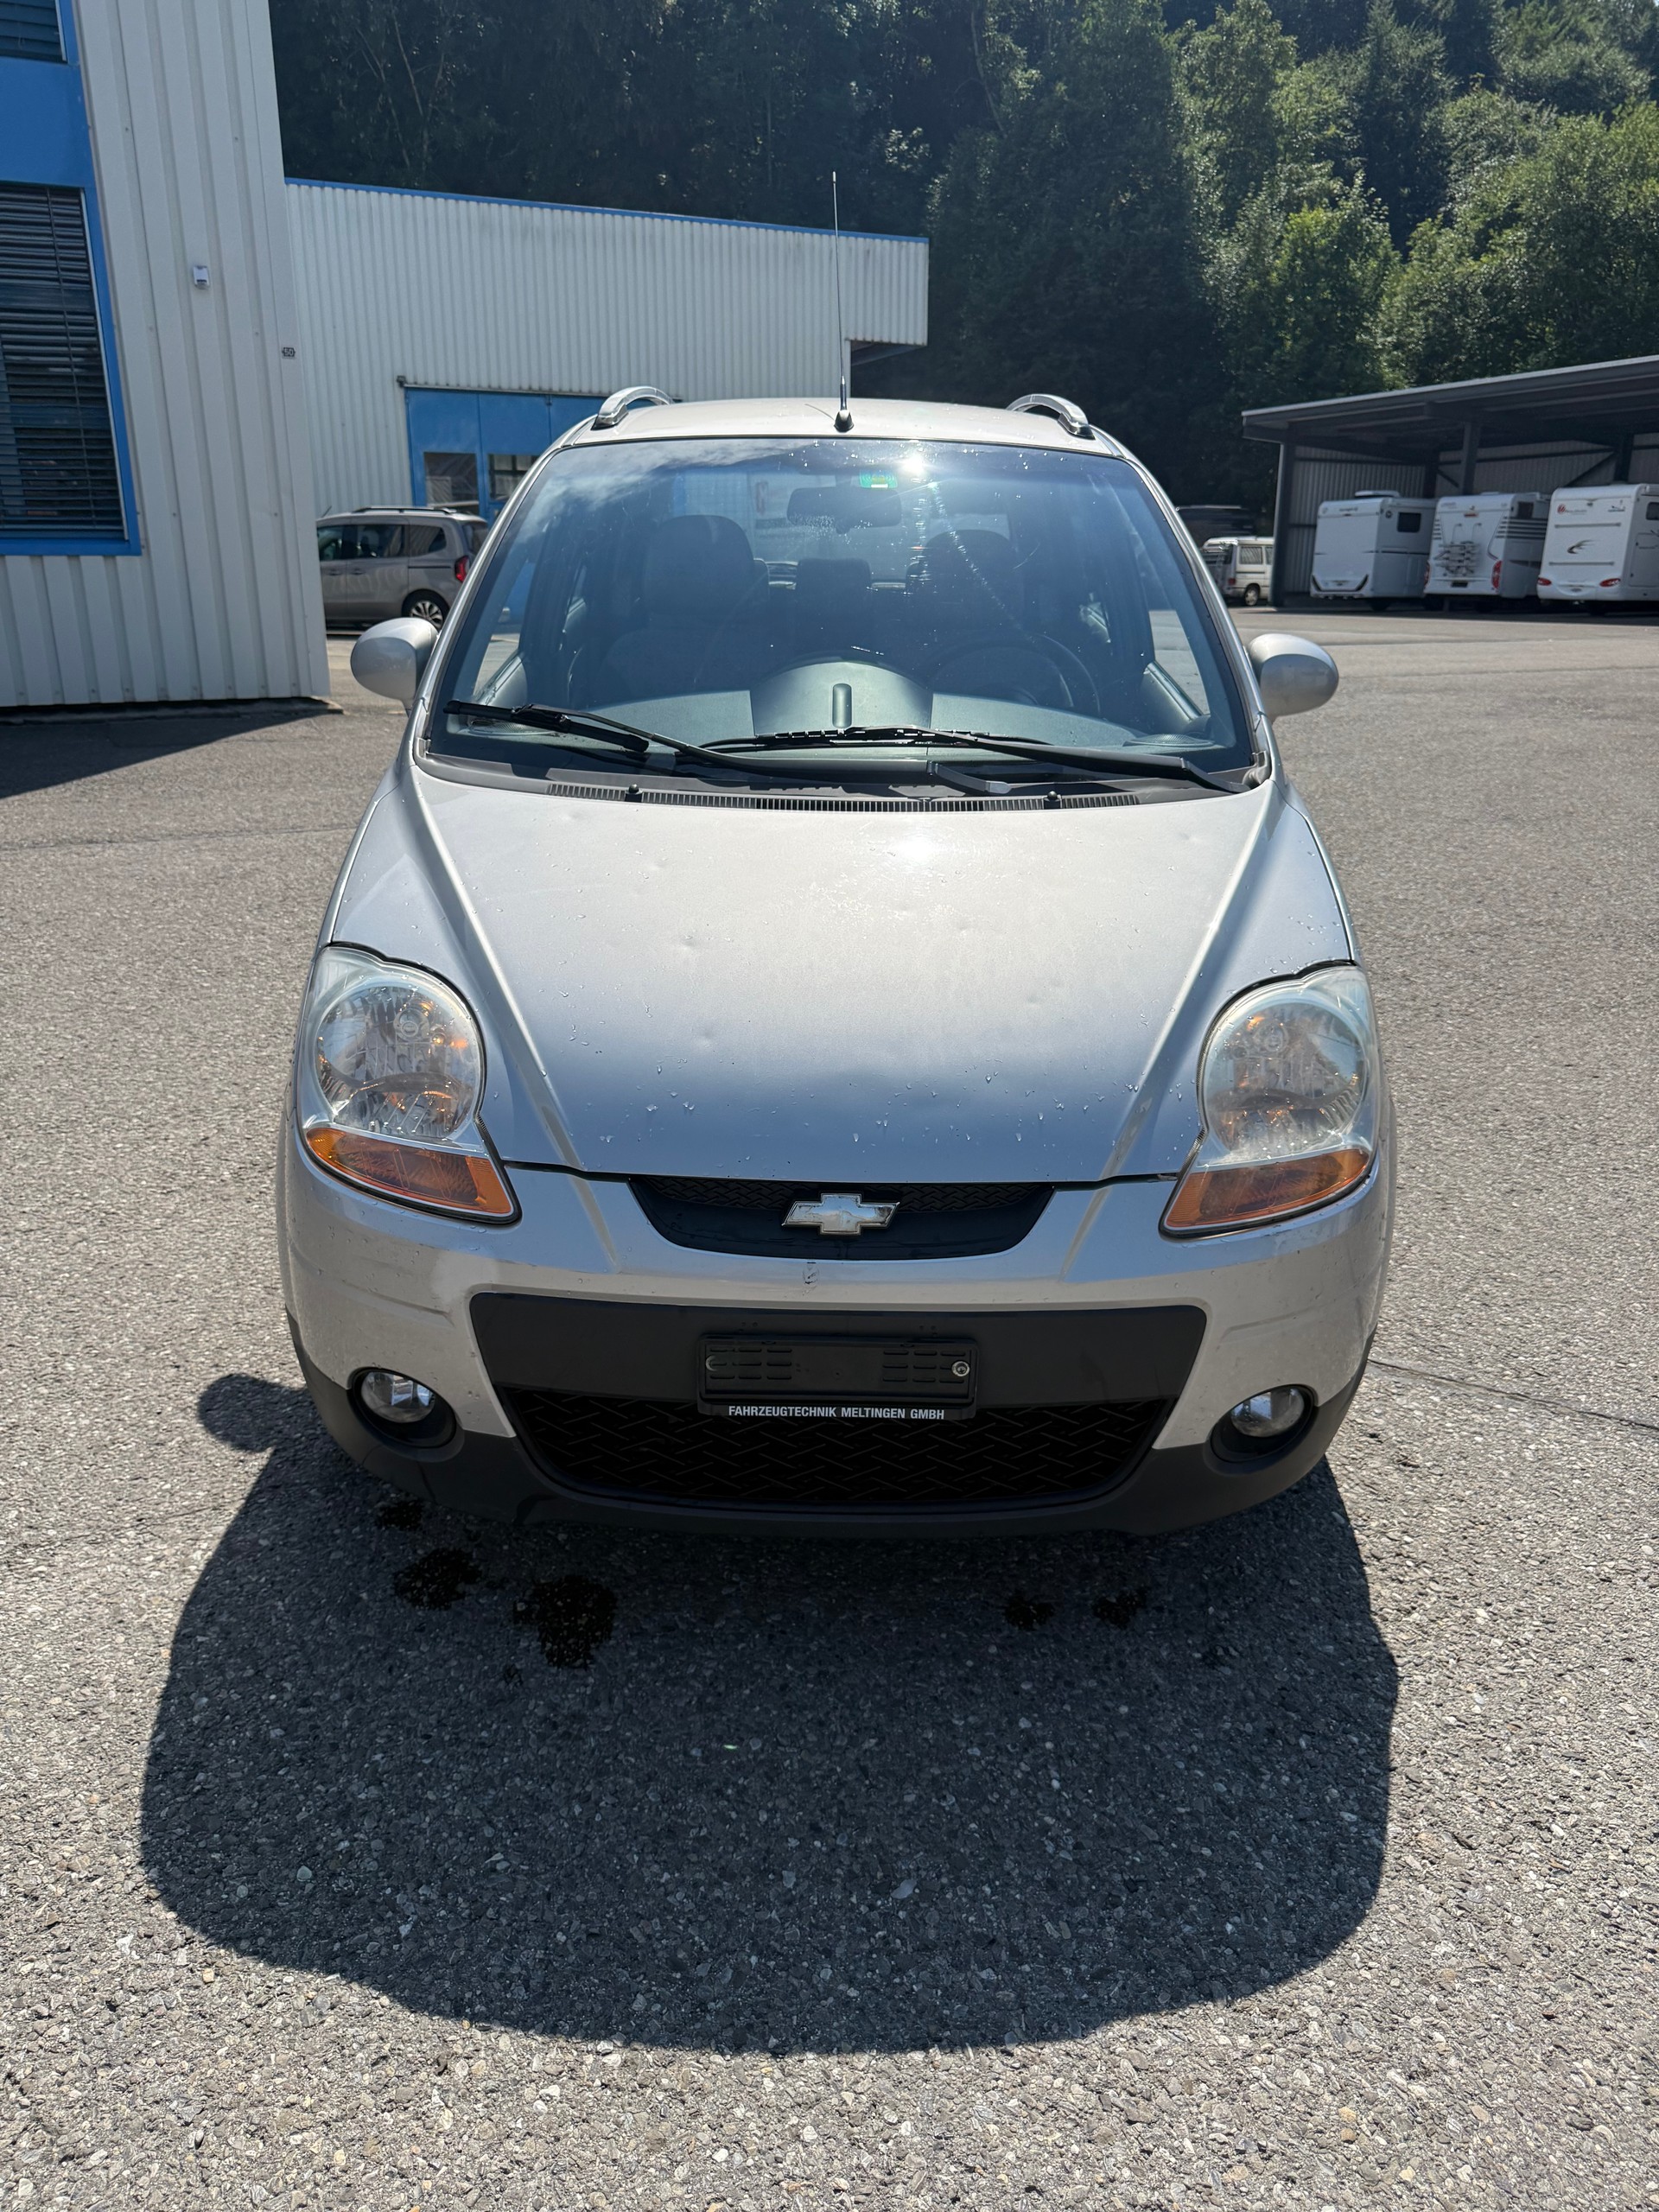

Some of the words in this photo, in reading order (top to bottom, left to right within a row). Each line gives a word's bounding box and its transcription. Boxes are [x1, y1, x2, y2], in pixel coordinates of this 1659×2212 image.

[728, 1406, 836, 1417] FAHRZEUGTECHNIK
[841, 1407, 906, 1419] MELTINGEN
[910, 1408, 944, 1420] GMBH
